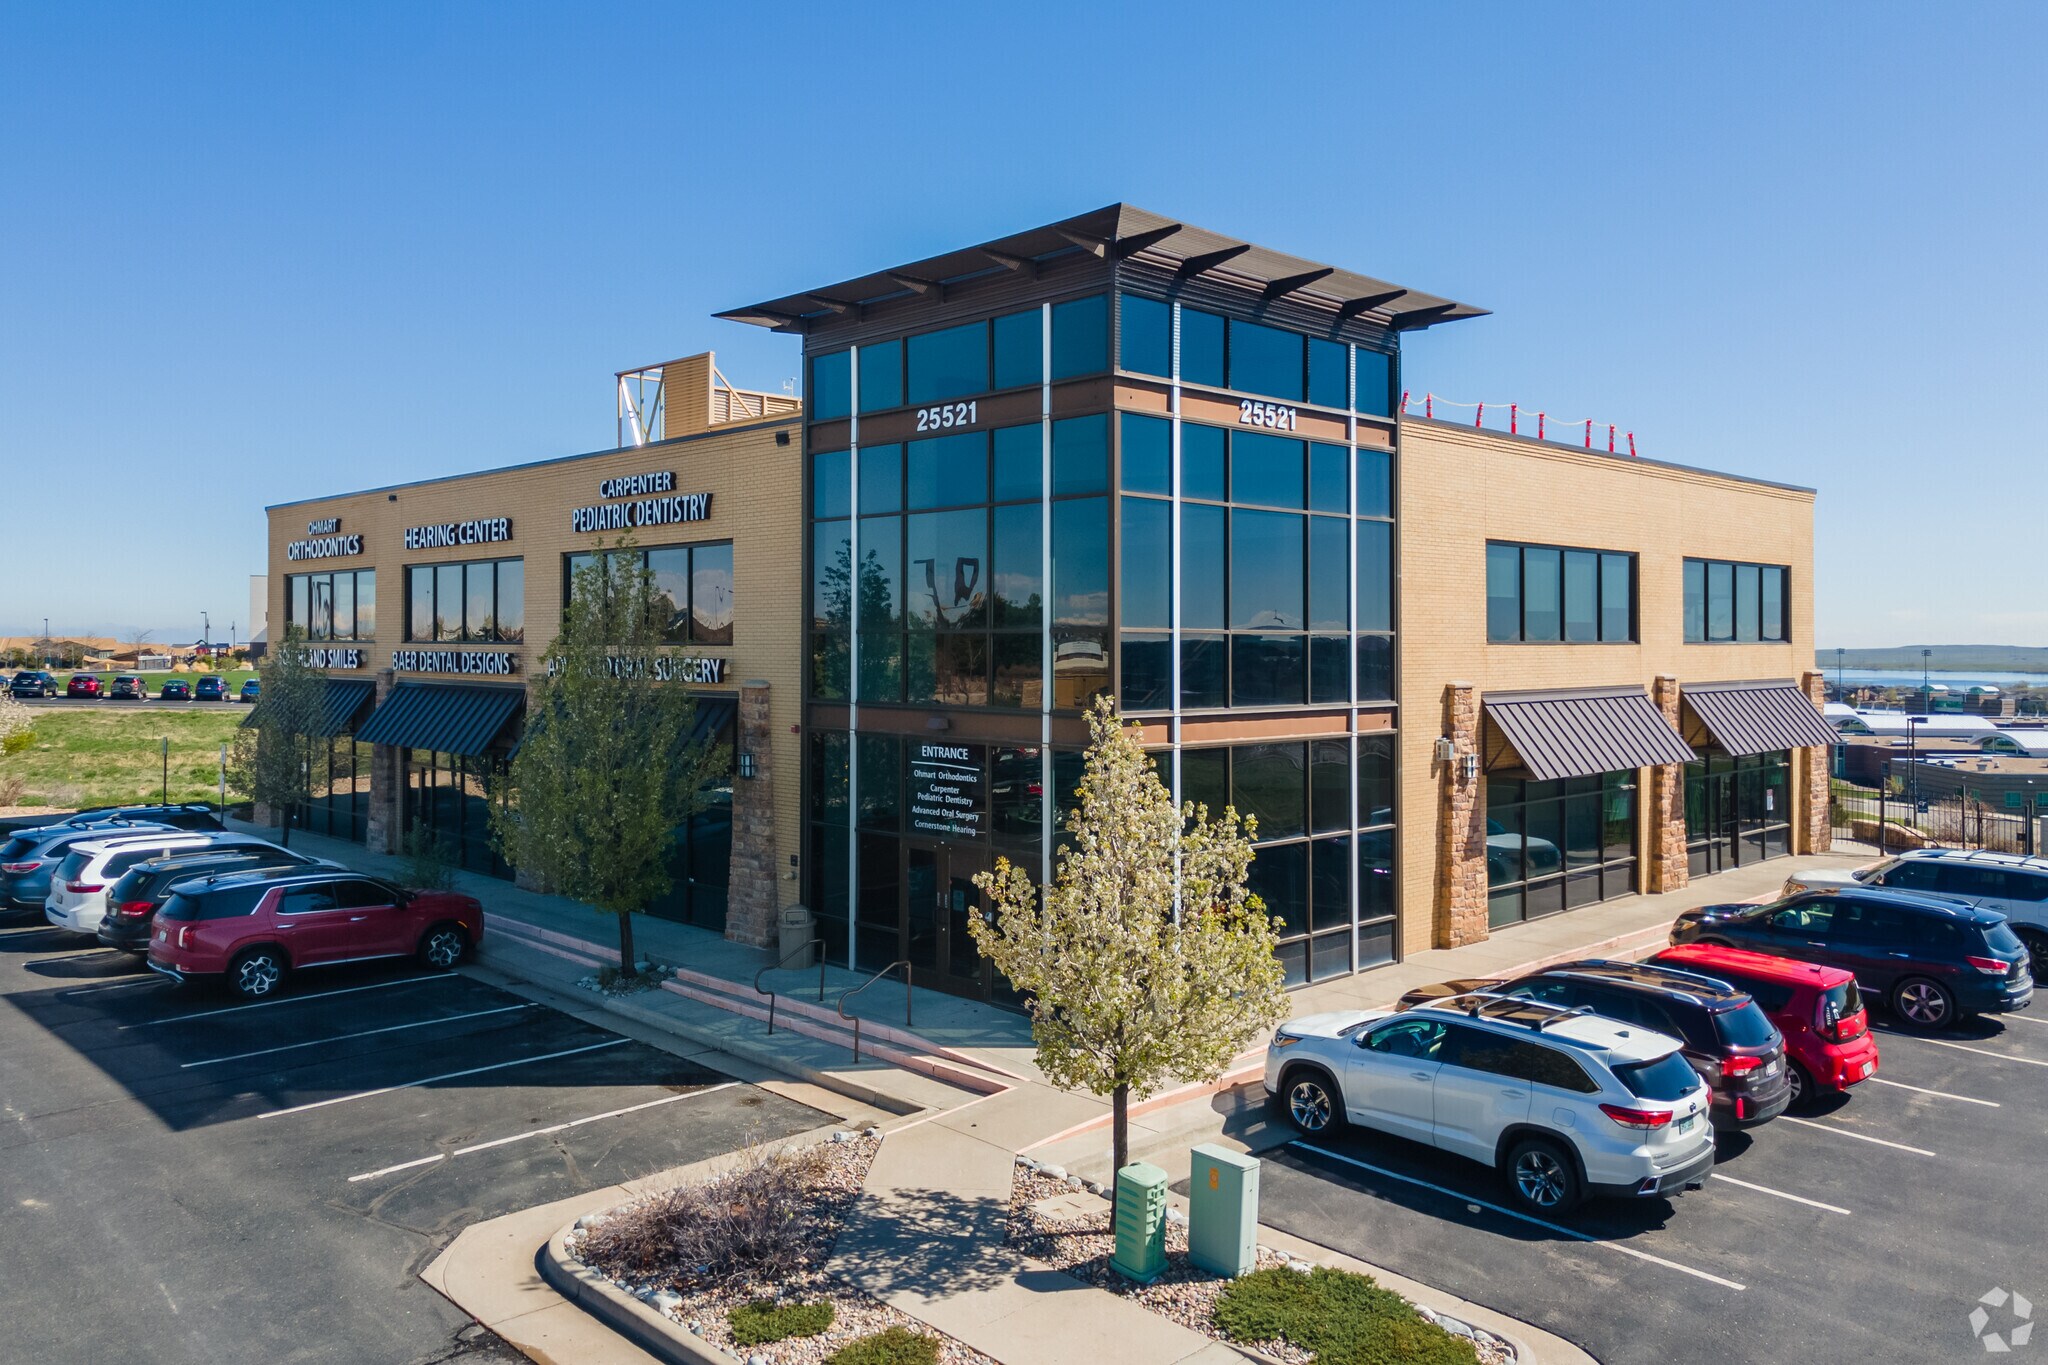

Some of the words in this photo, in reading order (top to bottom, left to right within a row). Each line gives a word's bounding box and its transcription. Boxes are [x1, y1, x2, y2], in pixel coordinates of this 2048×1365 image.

[916, 401, 977, 432] 25521
[1240, 400, 1297, 431] 25521
[600, 471, 672, 498] CARPENTER
[572, 502, 633, 533] PEDIATRIC
[636, 493, 709, 526] DENTISTRY
[307, 518, 337, 535] OHMART
[404, 524, 455, 550] HEARING
[459, 517, 508, 545] CENTER
[287, 534, 360, 561] ORTHODONTICS
[328, 649, 358, 669] SMILES
[392, 651, 417, 671] BAER
[419, 651, 459, 673] DENTAL
[461, 652, 510, 675] DESIGNS
[922, 746, 968, 760] ENTRANCE
[914, 770, 936, 779] Ohmart
[939, 771, 977, 783] Orthodontics
[930, 784, 959, 794] Carpenter
[917, 793, 943, 802] Pediatric
[945, 795, 973, 807] Dentistry
[912, 806, 940, 816] Advanced
[941, 809, 954, 818] Oral
[956, 812, 979, 823] Surgery
[915, 820, 950, 831] Cornerstone
[953, 825, 976, 836] Hearing
